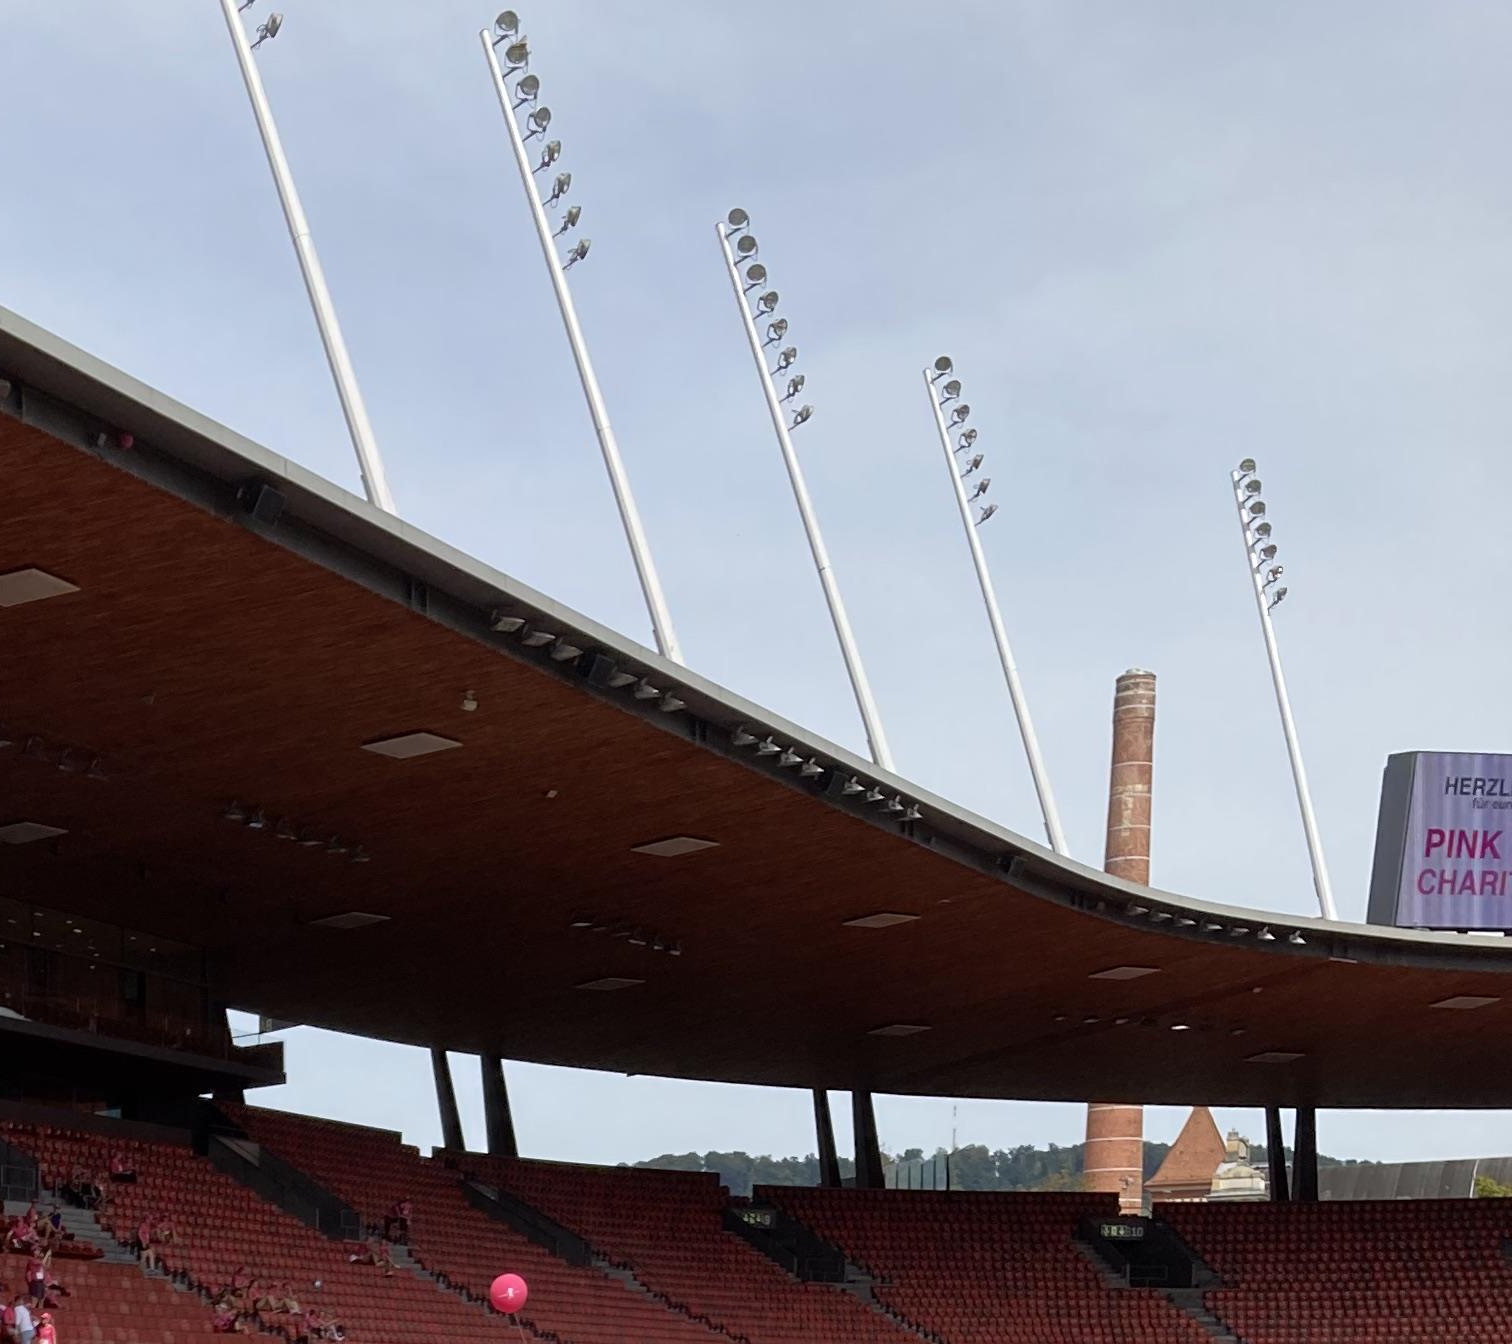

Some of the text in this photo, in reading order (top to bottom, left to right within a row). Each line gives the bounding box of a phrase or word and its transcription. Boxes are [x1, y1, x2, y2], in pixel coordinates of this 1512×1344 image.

[1445, 776, 1512, 797] HERZL
[1424, 828, 1505, 859] PINK
[1417, 868, 1512, 896] CHARI
